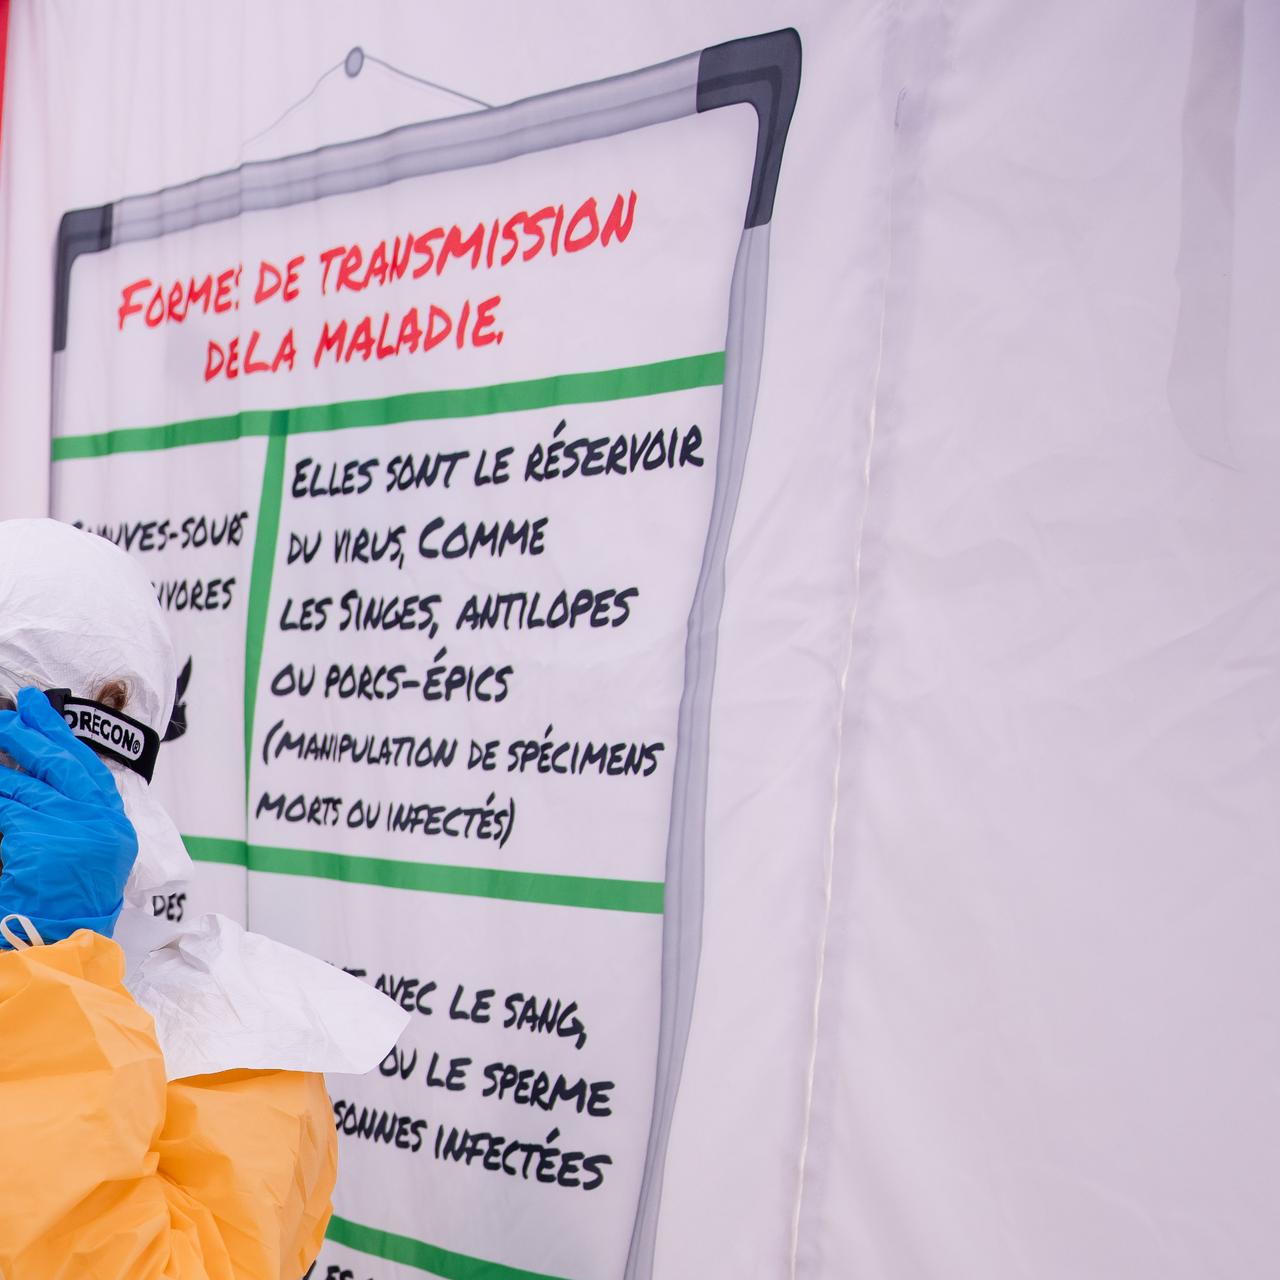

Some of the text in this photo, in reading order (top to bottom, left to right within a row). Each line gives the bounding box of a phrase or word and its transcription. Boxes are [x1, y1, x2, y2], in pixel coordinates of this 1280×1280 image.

[255, 256, 304, 304] DE
[320, 191, 637, 294] TRANSMISSION
[314, 295, 504, 368] MALADIE.
[292, 419, 704, 498] ELLES SONT LE RÉSERVOIR
[287, 531, 322, 565] DU
[334, 525, 406, 570] VIRUS,
[419, 517, 548, 559] COMME
[280, 587, 639, 639] LES SINGES, ANTILOPES
[271, 646, 514, 702] OU PORCS-ÉPICS
[263, 720, 665, 777] (MANIPULATION DE SPÉCIMENS
[255, 792, 515, 849] MORTS OU INFECTÉS)
[449, 984, 495, 1023] LE
[504, 993, 587, 1050] SANG,
[379, 1045, 615, 1117] OU LE SPERME
[333, 1100, 613, 1190] SONNES INFECTÉES
